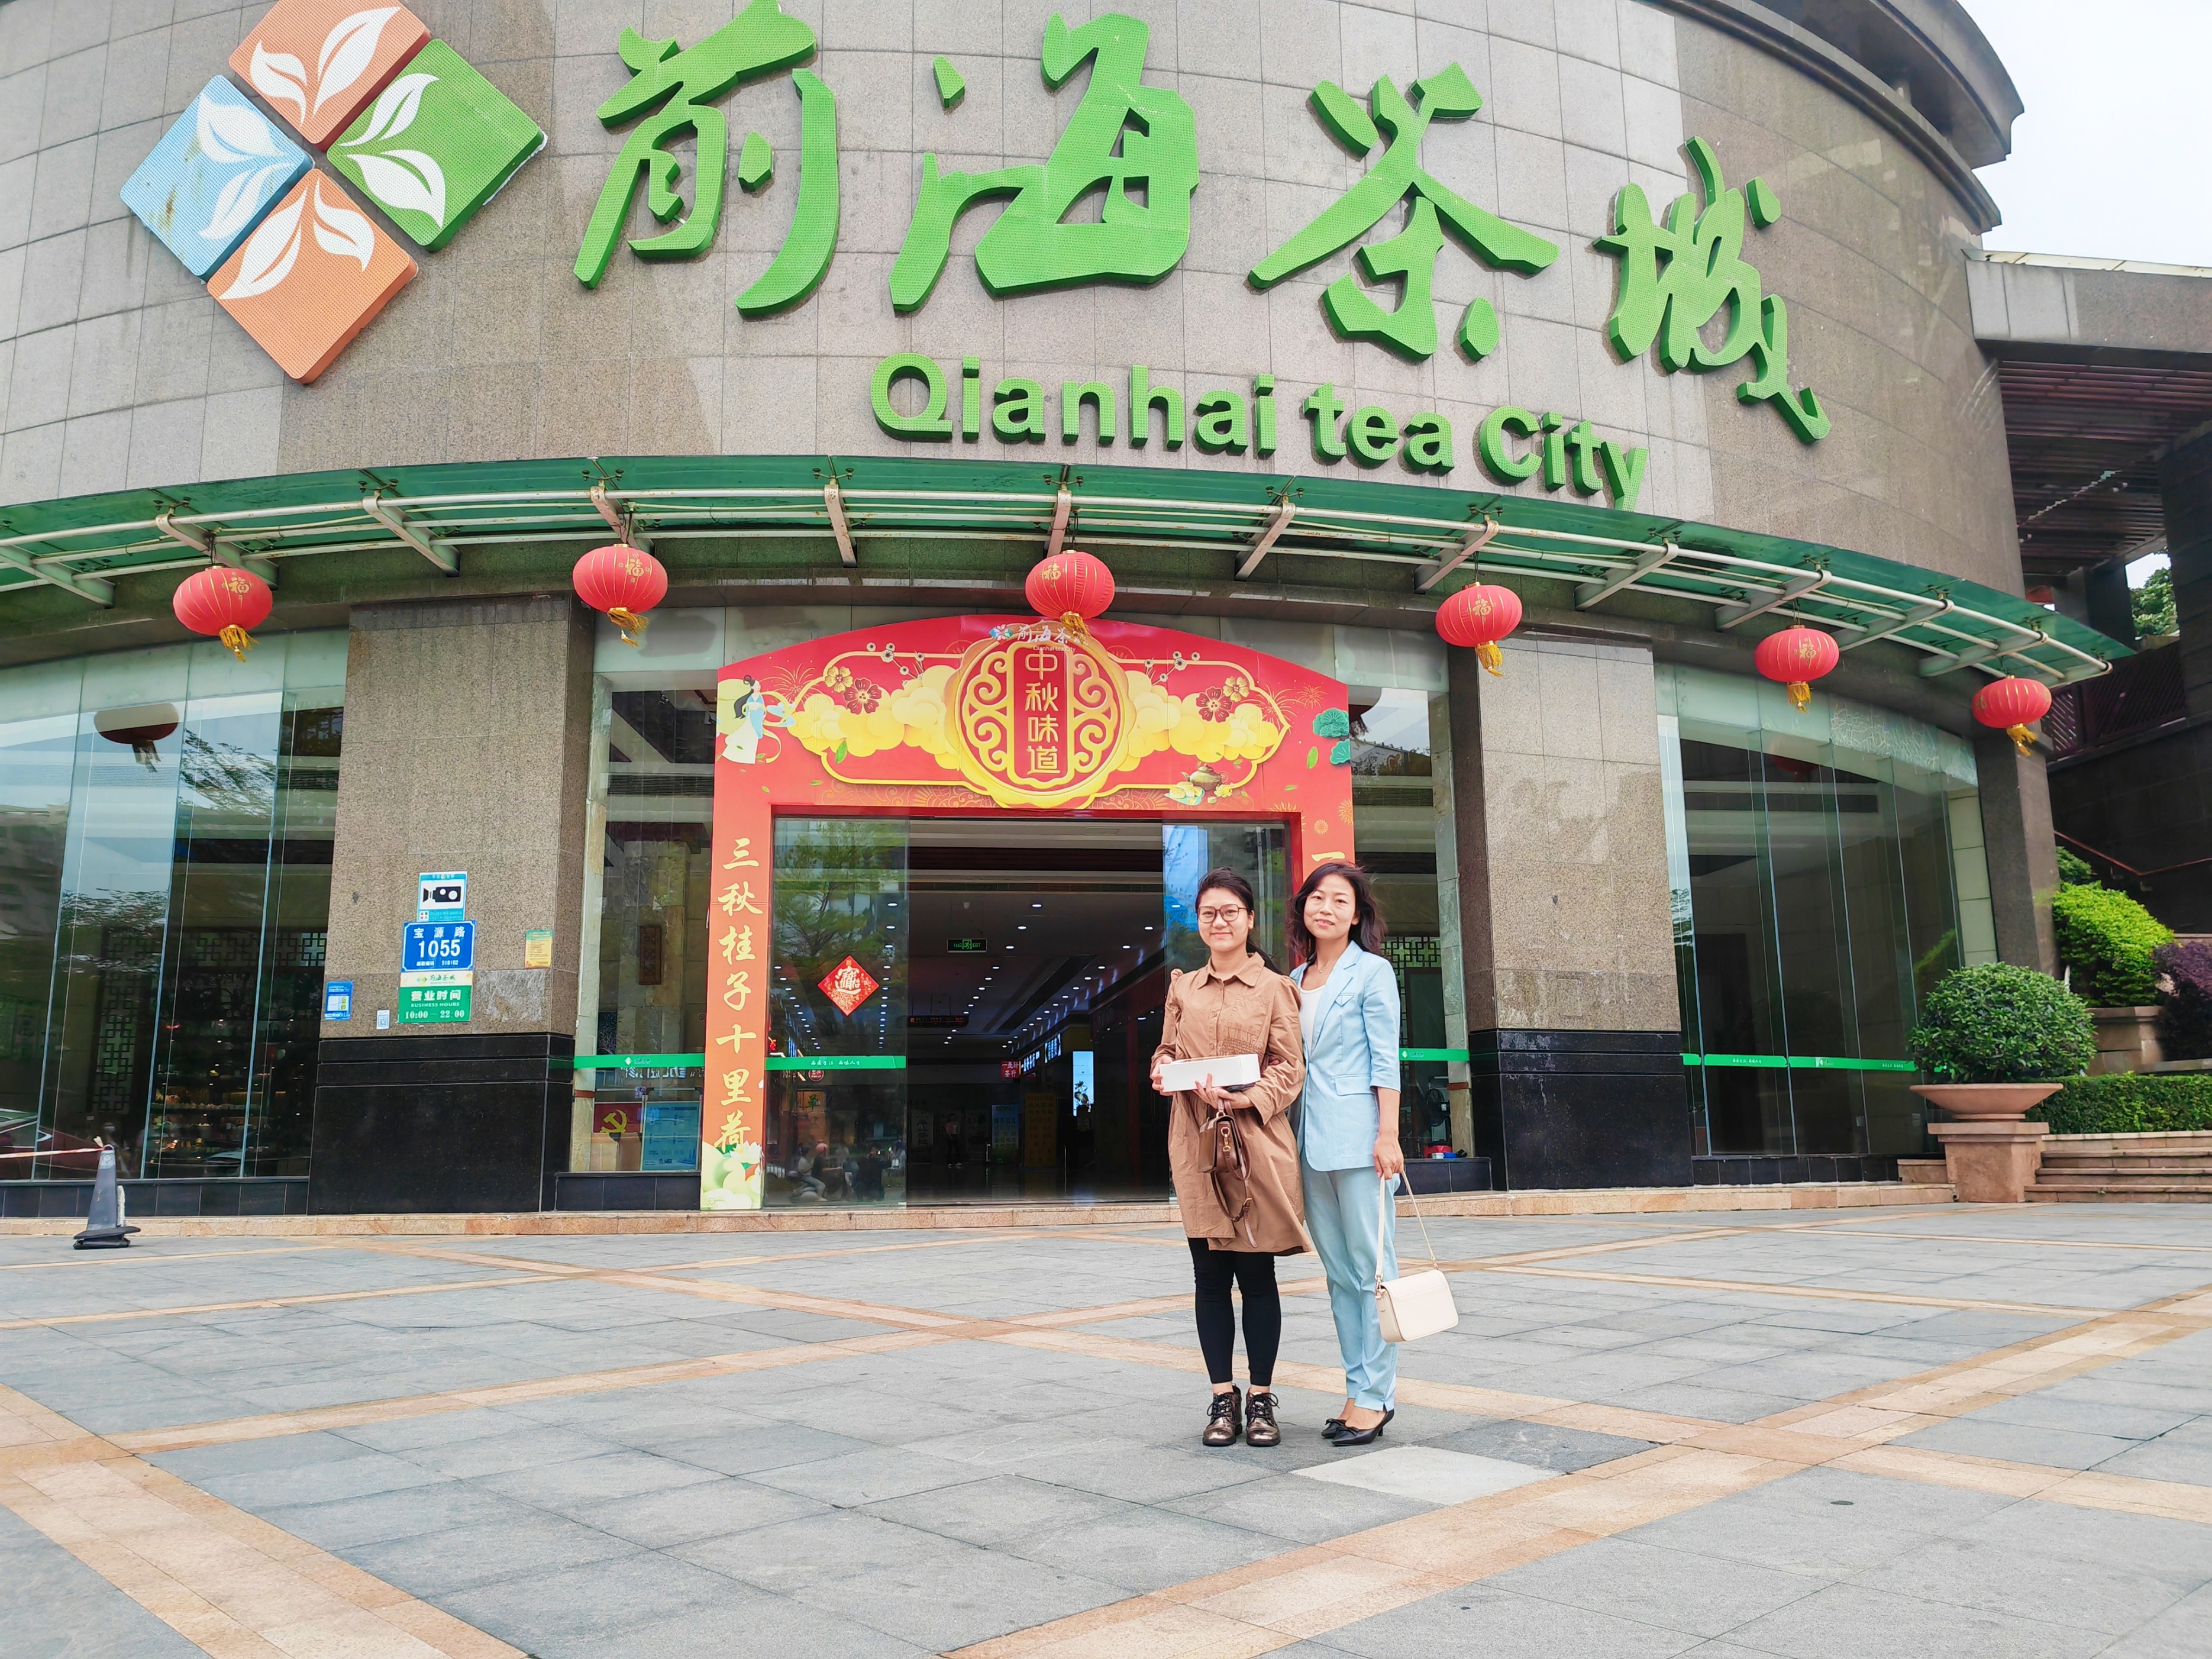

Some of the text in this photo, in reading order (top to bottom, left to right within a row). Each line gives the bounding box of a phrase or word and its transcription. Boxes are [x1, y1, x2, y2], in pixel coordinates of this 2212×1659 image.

[573, 0, 1832, 444] 前海茶城
[870, 353, 1649, 512] Qianhai tea City
[625, 559, 644, 577] 福
[1044, 563, 1061, 580] 福
[228, 576, 249, 593] 福
[1472, 598, 1491, 616] 福
[1800, 643, 1816, 659] 福
[1025, 650, 1061, 775] 中秋味道
[414, 926, 466, 938] 宝源路
[418, 939, 461, 958] 1055
[411, 989, 461, 1001] 营业时间
[713, 837, 764, 1155] 三秋桂子十里荷
[405, 1011, 428, 1019] 10:00
[440, 1009, 465, 1018] 22:00
